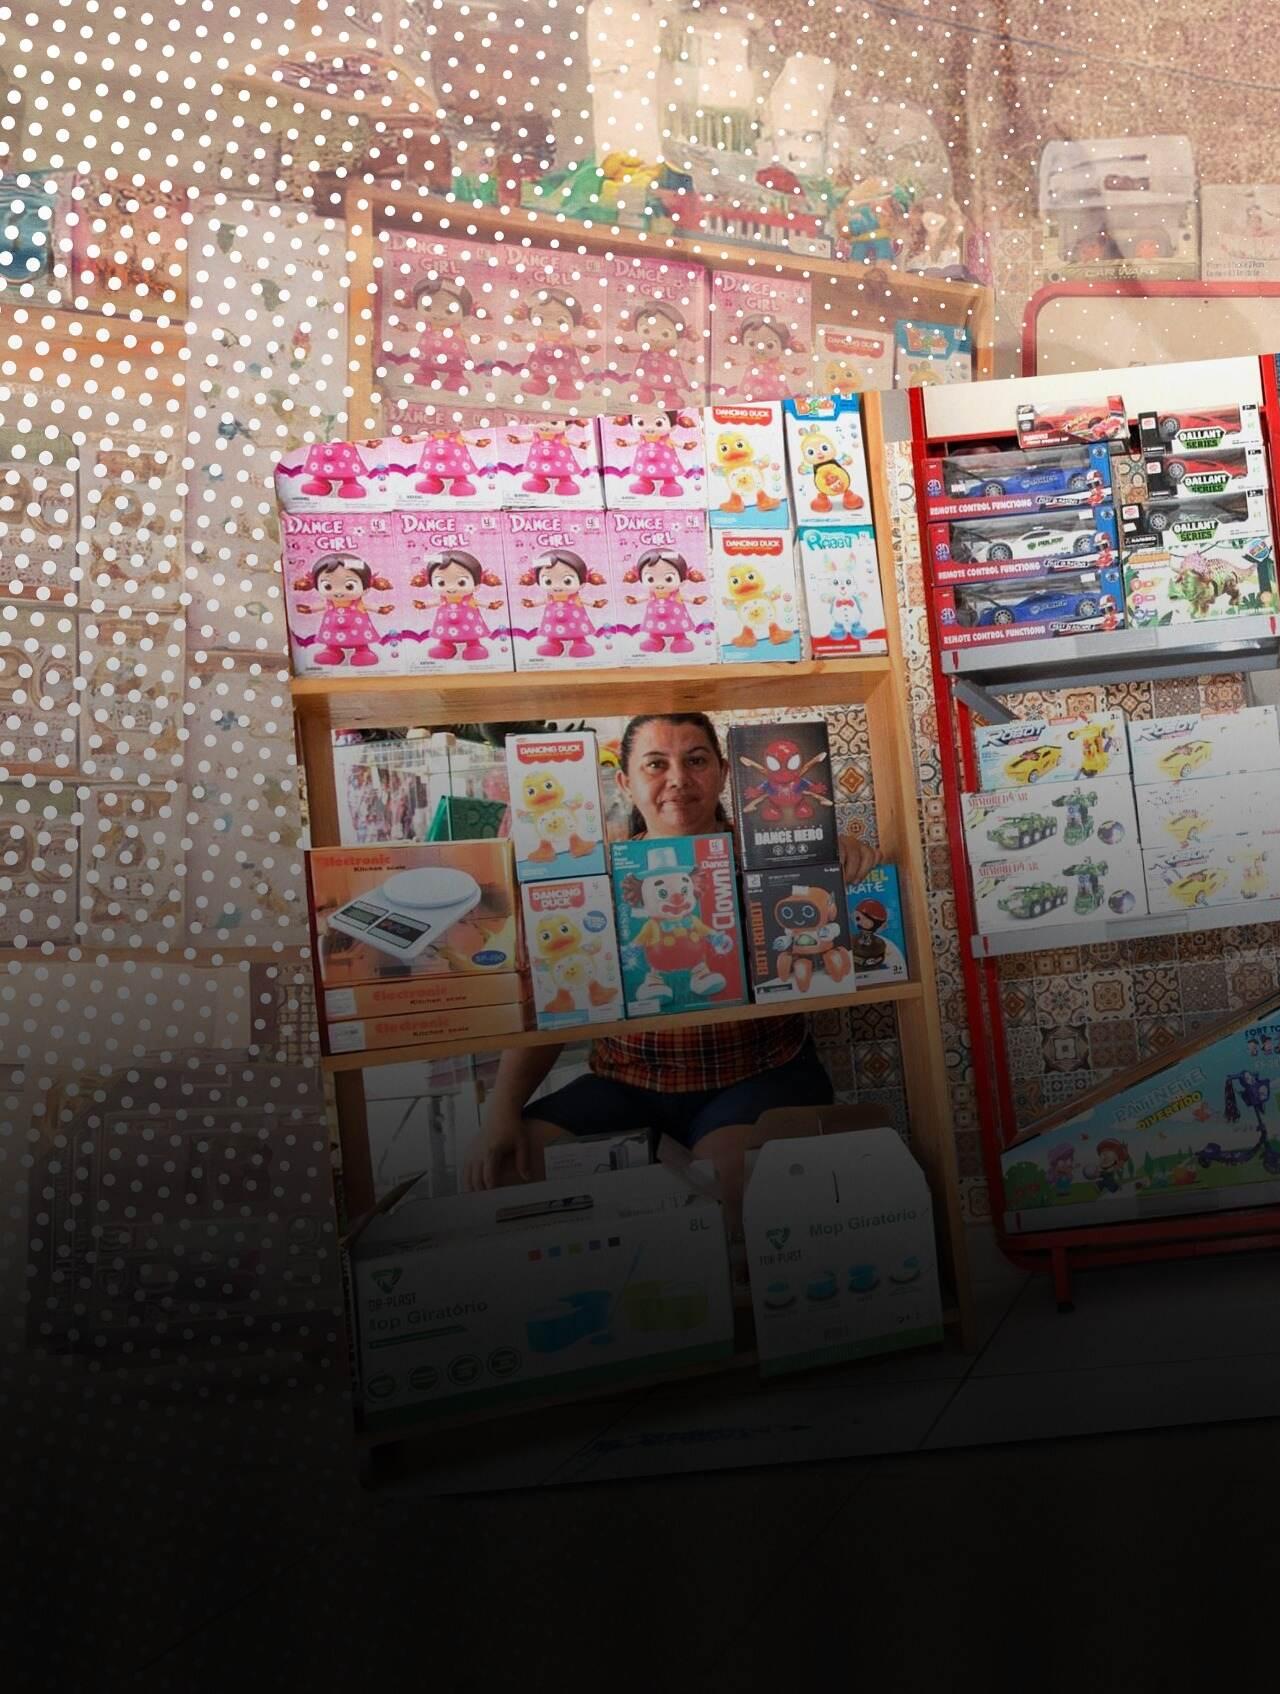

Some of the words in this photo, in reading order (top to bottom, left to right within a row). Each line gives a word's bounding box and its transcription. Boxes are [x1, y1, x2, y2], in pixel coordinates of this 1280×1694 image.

[715, 408, 748, 417] DANCING
[1179, 429, 1222, 441] GALLANT
[1186, 439, 1218, 449] SERIES
[1184, 474, 1227, 486] GALLANT
[930, 505, 957, 516] REMOTE
[959, 502, 991, 514] CONTROL
[286, 515, 344, 534] DANCE
[401, 514, 456, 534] DANCE
[510, 514, 561, 532] DANCE
[614, 513, 664, 531] DANCE
[1173, 520, 1218, 533] GALLANT
[315, 535, 359, 551] GIRL
[430, 534, 469, 549] GIRL
[536, 532, 575, 547] GIRL
[640, 532, 676, 546] GIRL
[1179, 530, 1213, 542] SERIES
[725, 540, 759, 548] DANCING
[761, 539, 780, 547] DUCK
[938, 570, 966, 579] REMOTE
[967, 566, 999, 577] CONTROL
[944, 634, 971, 644] REMOTE
[972, 631, 1003, 642] CONTROL
[982, 725, 1046, 748] ROBOT
[520, 744, 557, 755] DANCING
[558, 743, 581, 752] DUCK
[754, 829, 792, 846] DANCE
[794, 828, 824, 842] HERO
[702, 860, 730, 869] Dance
[532, 887, 581, 901] DANCING
[711, 868, 736, 930] Clown
[809, 1223, 843, 1238] Mop
[848, 1207, 917, 1231] Giratório
[407, 1300, 488, 1325] Giratório
